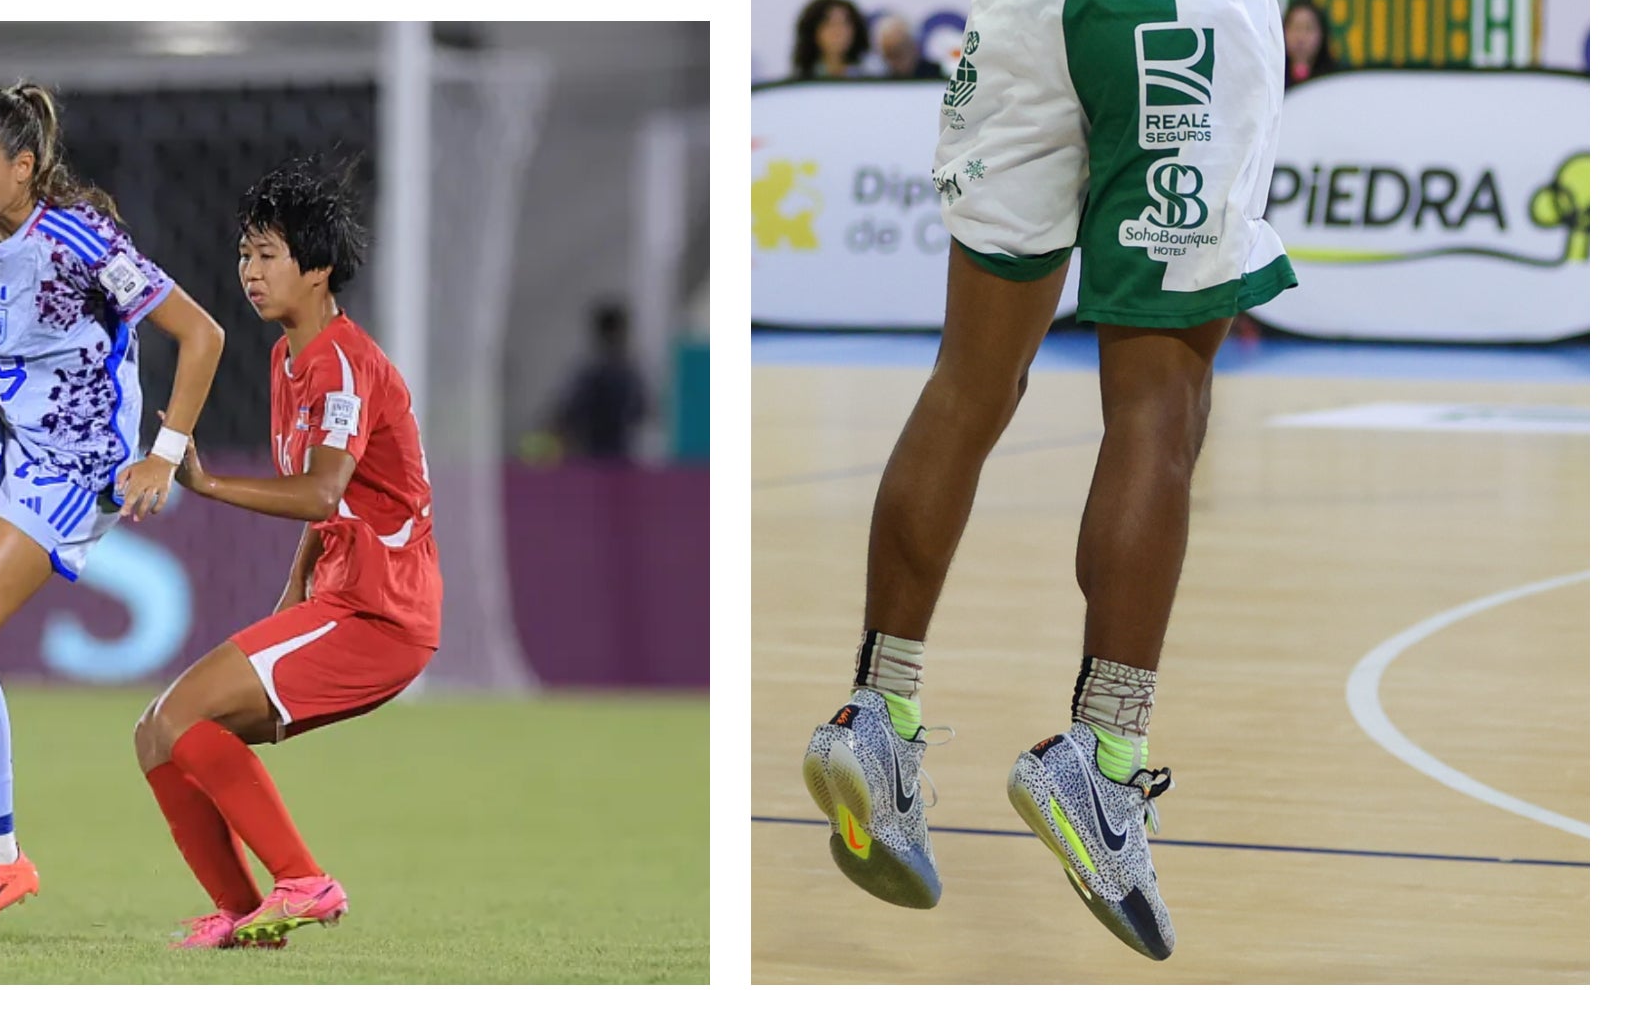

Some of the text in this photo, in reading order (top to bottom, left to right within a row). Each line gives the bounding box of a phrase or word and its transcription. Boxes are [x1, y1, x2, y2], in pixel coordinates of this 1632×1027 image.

[1145, 113, 1212, 129] REALE
[1145, 130, 1212, 143] SEGUROS
[845, 215, 901, 255] de
[1153, 246, 1187, 256] HOTELS
